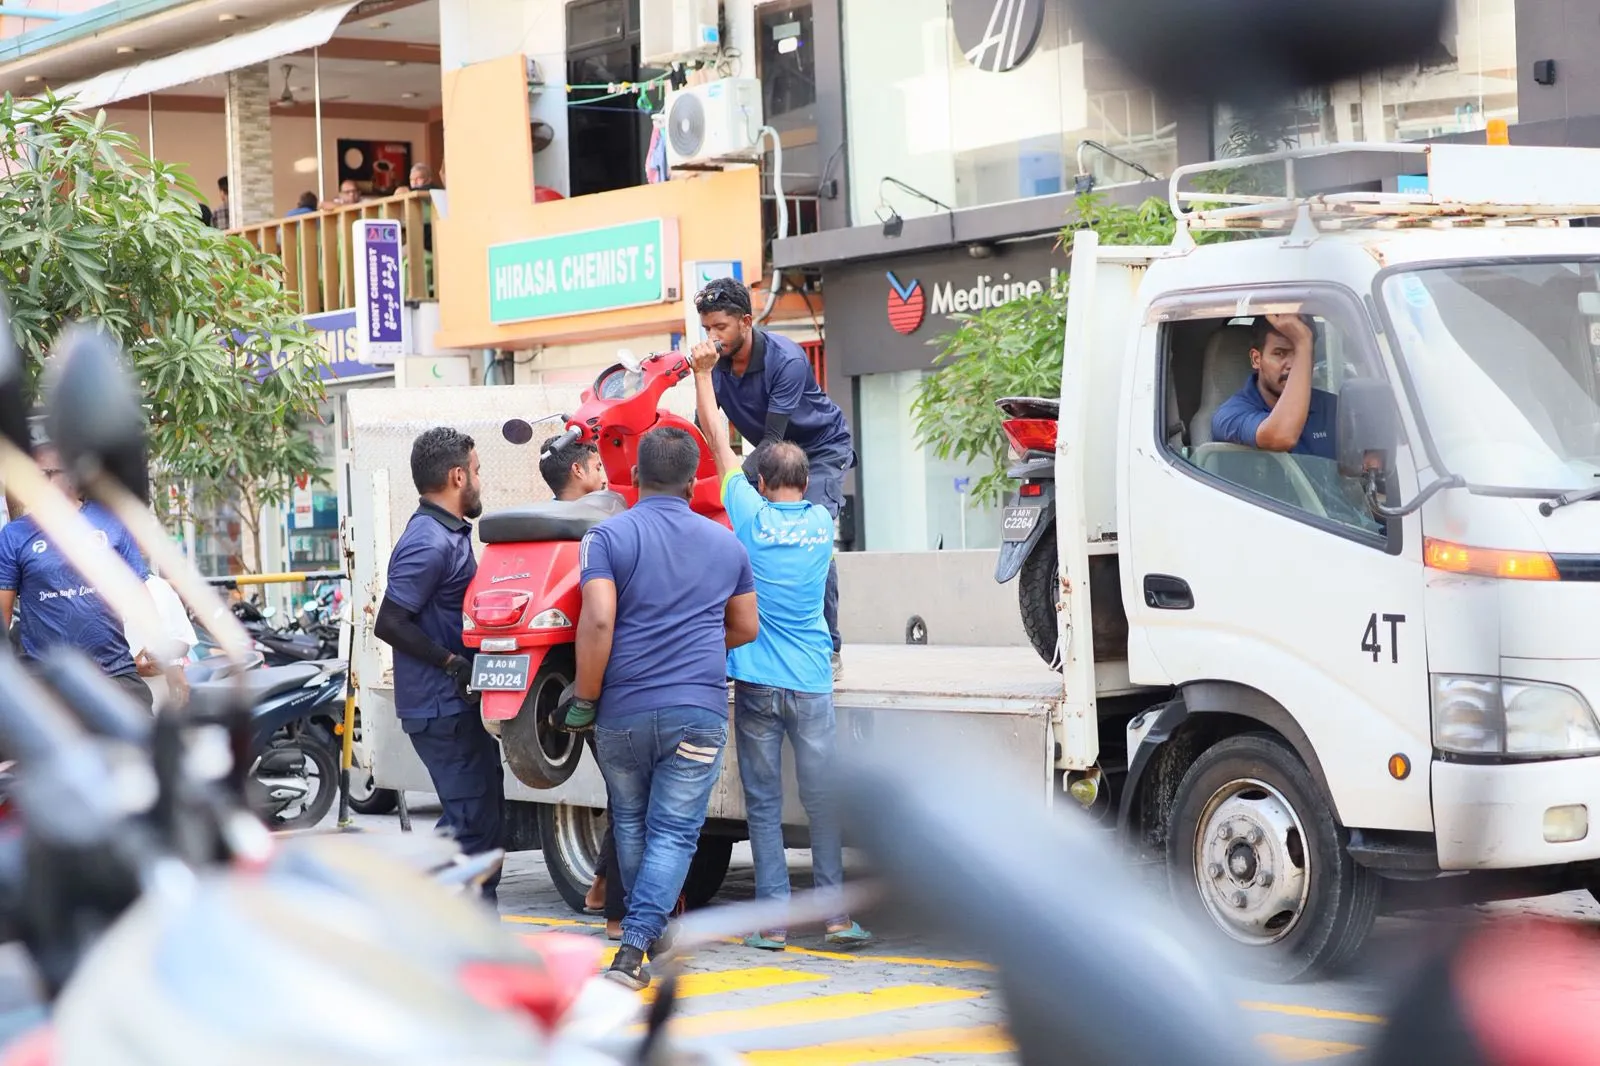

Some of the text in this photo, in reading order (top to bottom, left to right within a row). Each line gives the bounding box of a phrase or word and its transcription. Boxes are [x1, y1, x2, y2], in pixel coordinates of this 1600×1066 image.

[495, 243, 655, 301] HIRASA CHEMIST 5
[368, 247, 381, 337] POINT CHEMIST
[931, 272, 1043, 314] Medicine
[1004, 517, 1033, 529] C2264
[39, 591, 58, 601] Drive
[60, 588, 77, 598] safe
[1361, 612, 1406, 664] 4T
[508, 659, 516, 668] M
[478, 673, 521, 686] P3024
